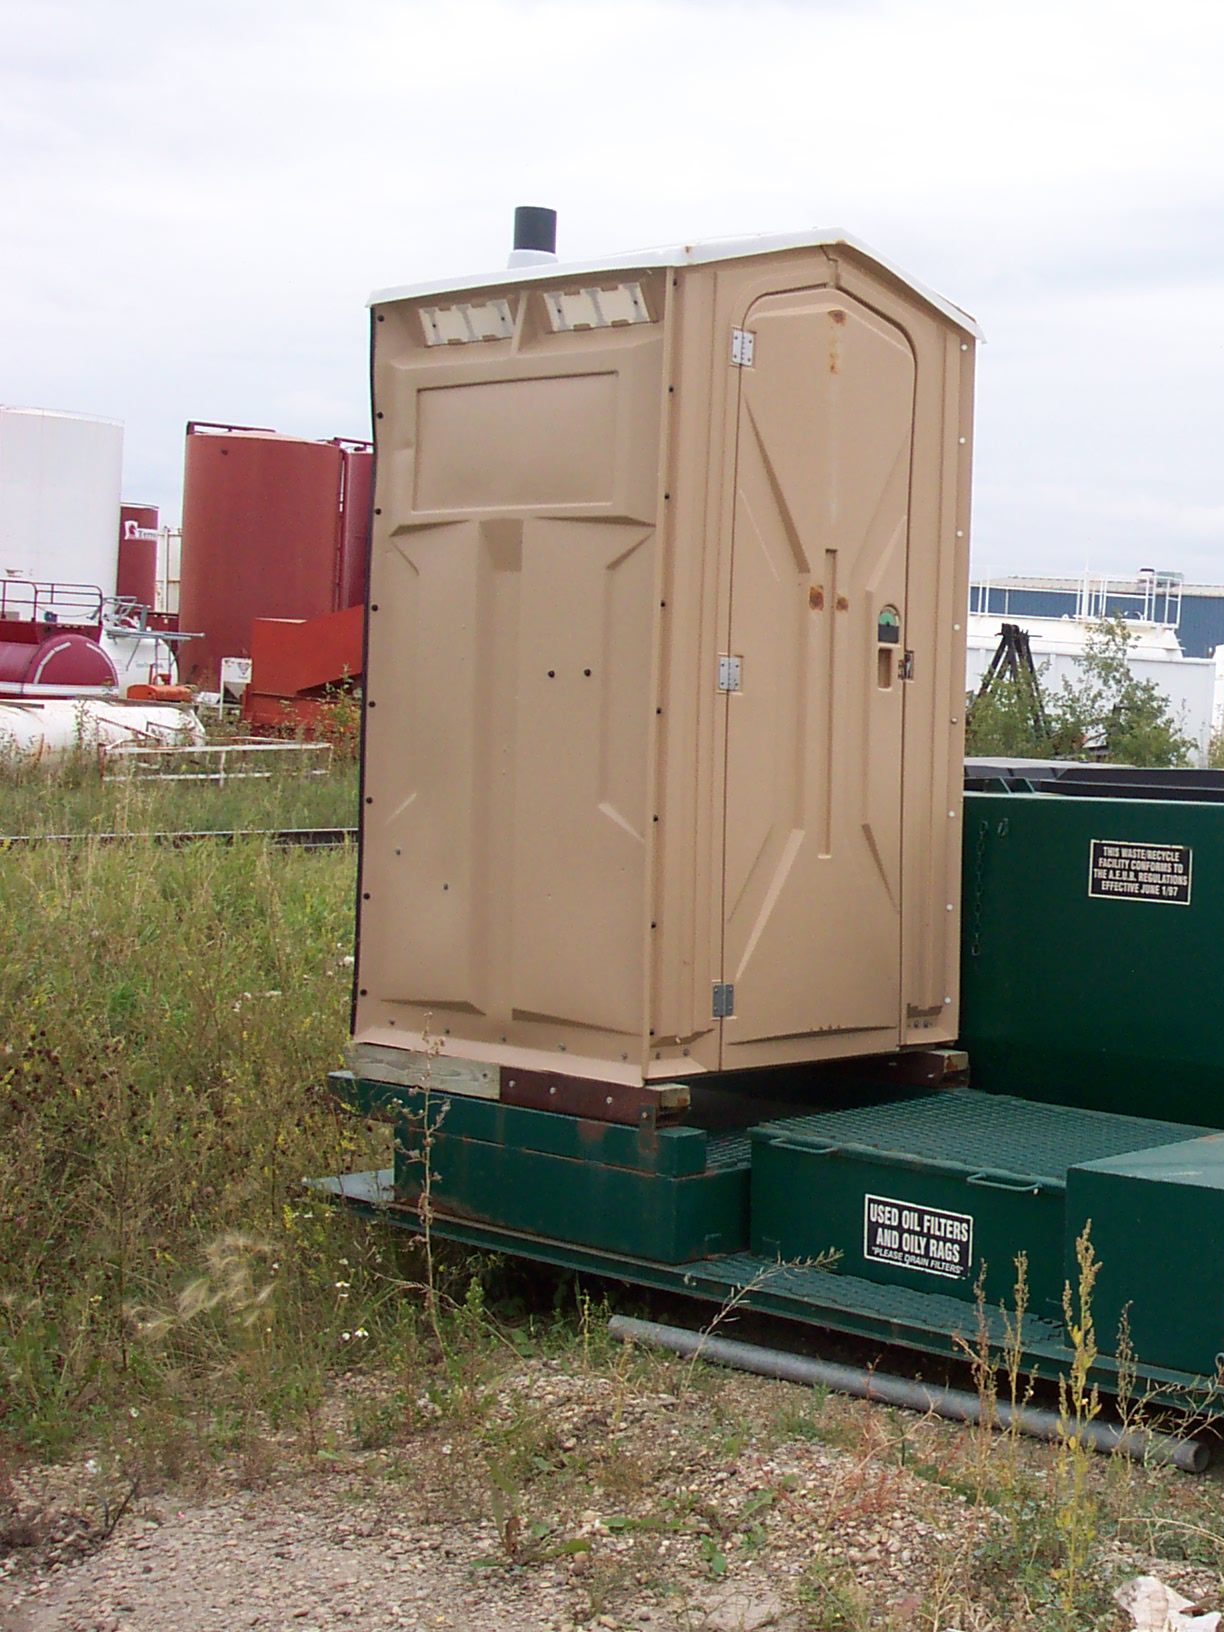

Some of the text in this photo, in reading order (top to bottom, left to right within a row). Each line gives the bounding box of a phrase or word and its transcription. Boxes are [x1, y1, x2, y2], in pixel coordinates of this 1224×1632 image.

[1104, 847, 1180, 862] THIS WASTE RECYCLE
[1099, 858, 1183, 873] FACILITY CONFORMS TO
[1094, 869, 1107, 879] THE
[1138, 873, 1188, 885] REGULATIONS
[1101, 881, 1139, 893] EFFECTIVE
[1141, 884, 1160, 895] JUNE
[870, 1203, 968, 1241] USED OIL FILTERS
[876, 1228, 960, 1263] AND OILY RAGS
[904, 1254, 929, 1266] DRAIN
